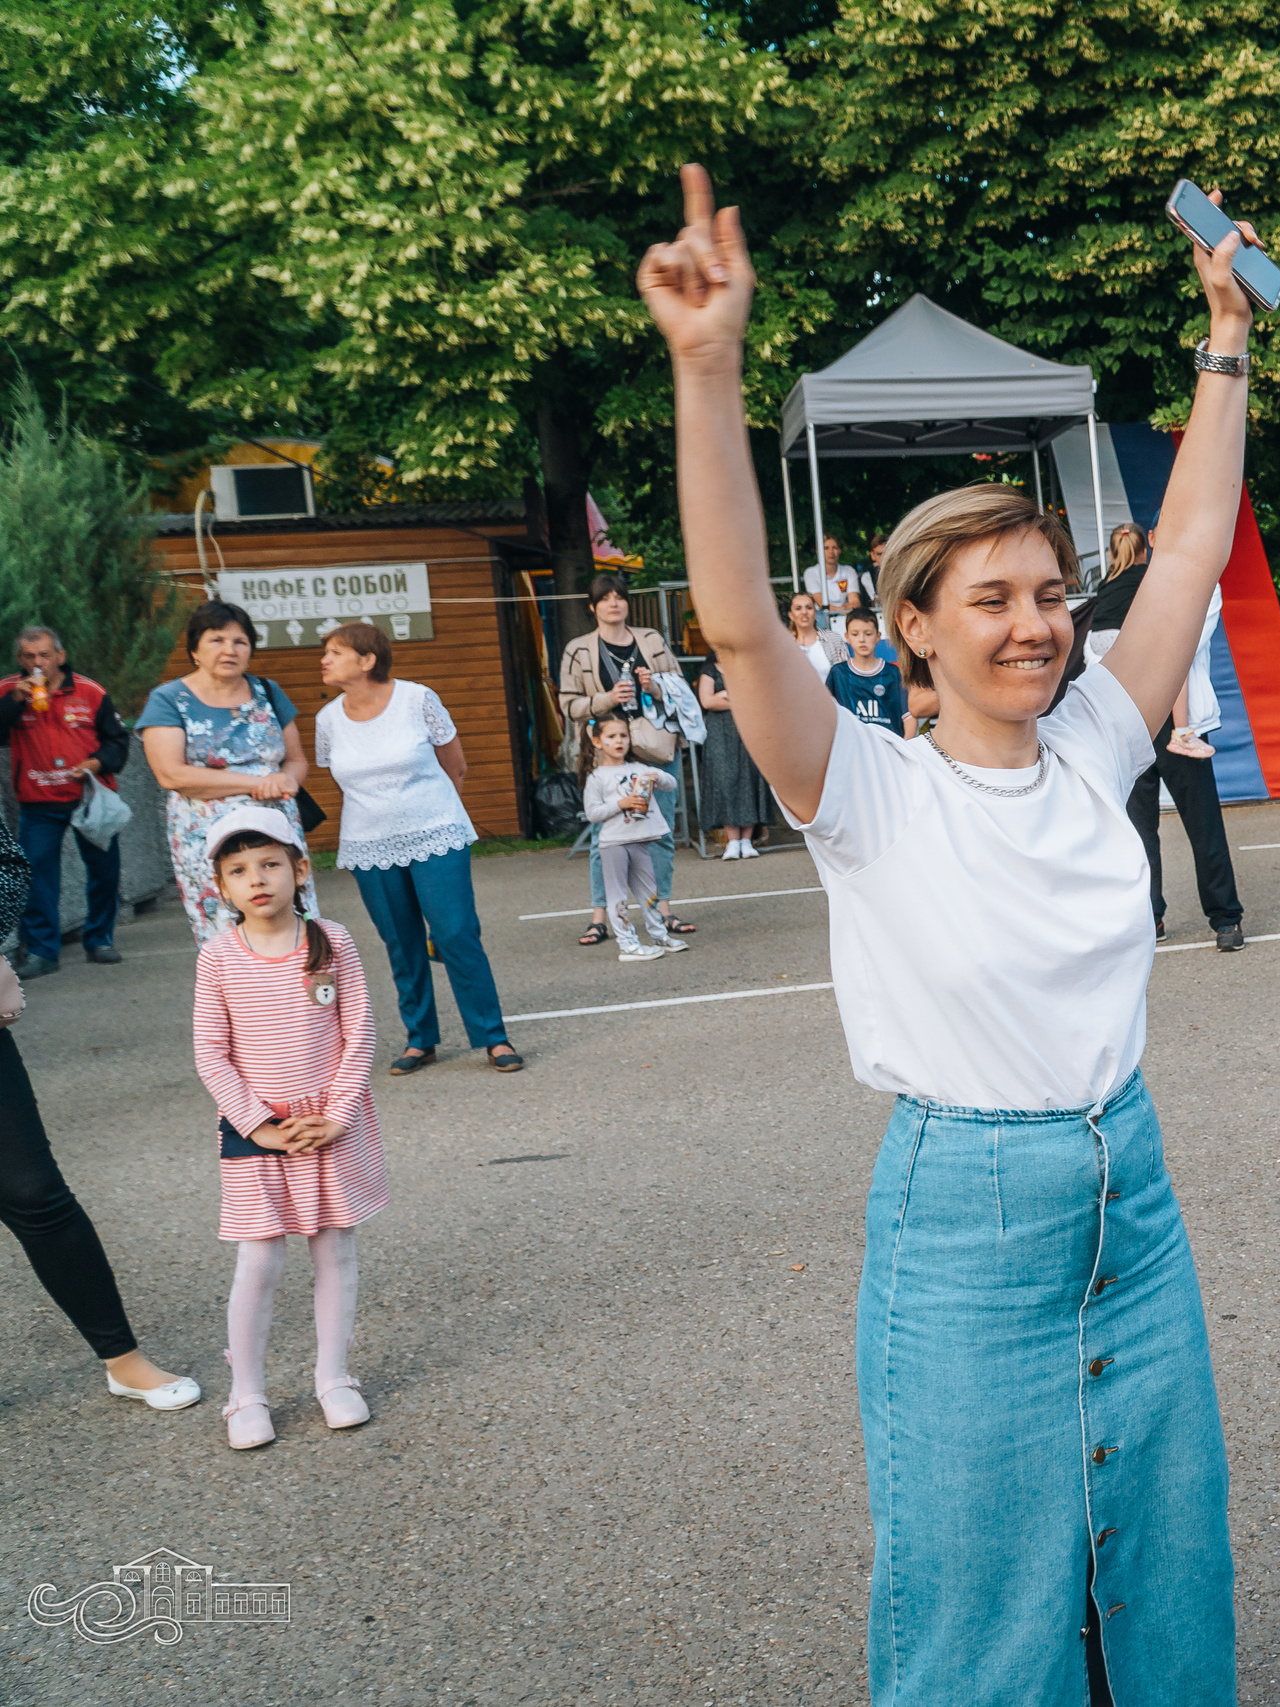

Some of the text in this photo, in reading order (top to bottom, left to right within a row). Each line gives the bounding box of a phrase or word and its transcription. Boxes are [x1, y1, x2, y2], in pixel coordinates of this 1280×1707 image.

[242, 578, 306, 600] КОФЕ
[333, 568, 408, 596] СОБОЙ
[245, 595, 408, 617] COFFEE TO GO
